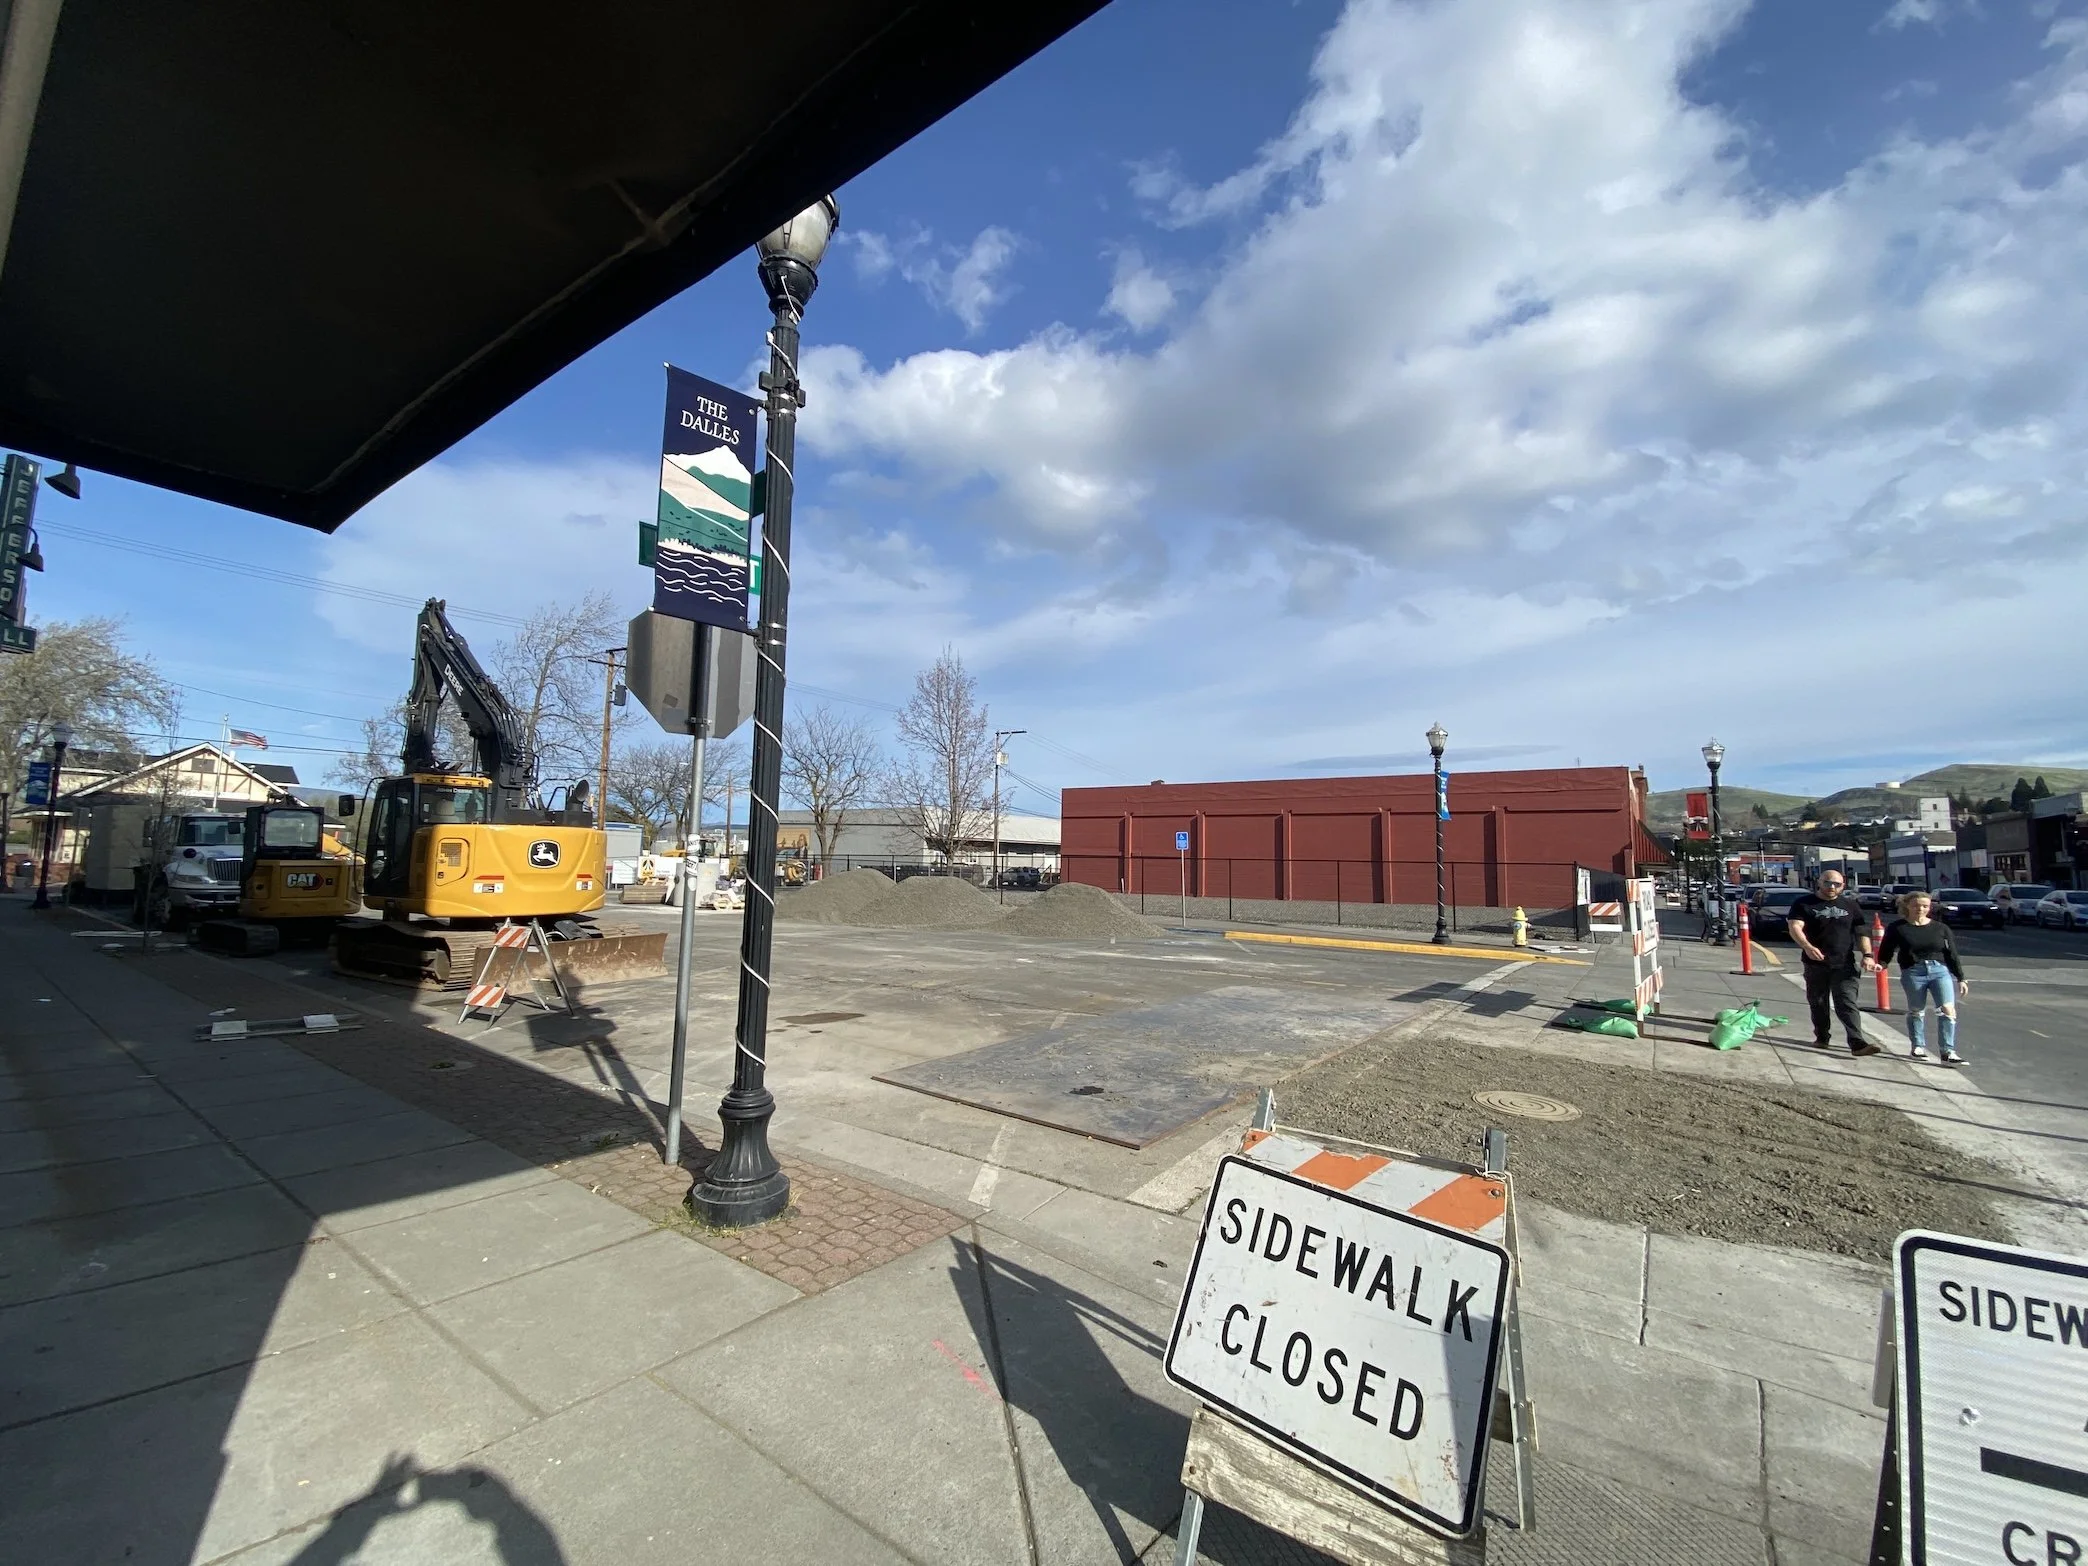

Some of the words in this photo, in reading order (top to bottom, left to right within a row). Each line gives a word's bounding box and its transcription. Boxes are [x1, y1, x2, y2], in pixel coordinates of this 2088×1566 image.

[697, 396, 728, 421] THE
[680, 410, 740, 445] DALLES
[0, 464, 34, 620] JEFFERSO
[444, 663, 464, 697] DEERE
[287, 873, 316, 888] CAT
[1220, 1198, 1479, 1342] SIDEWALK
[1221, 1303, 1424, 1441] CLOSED
